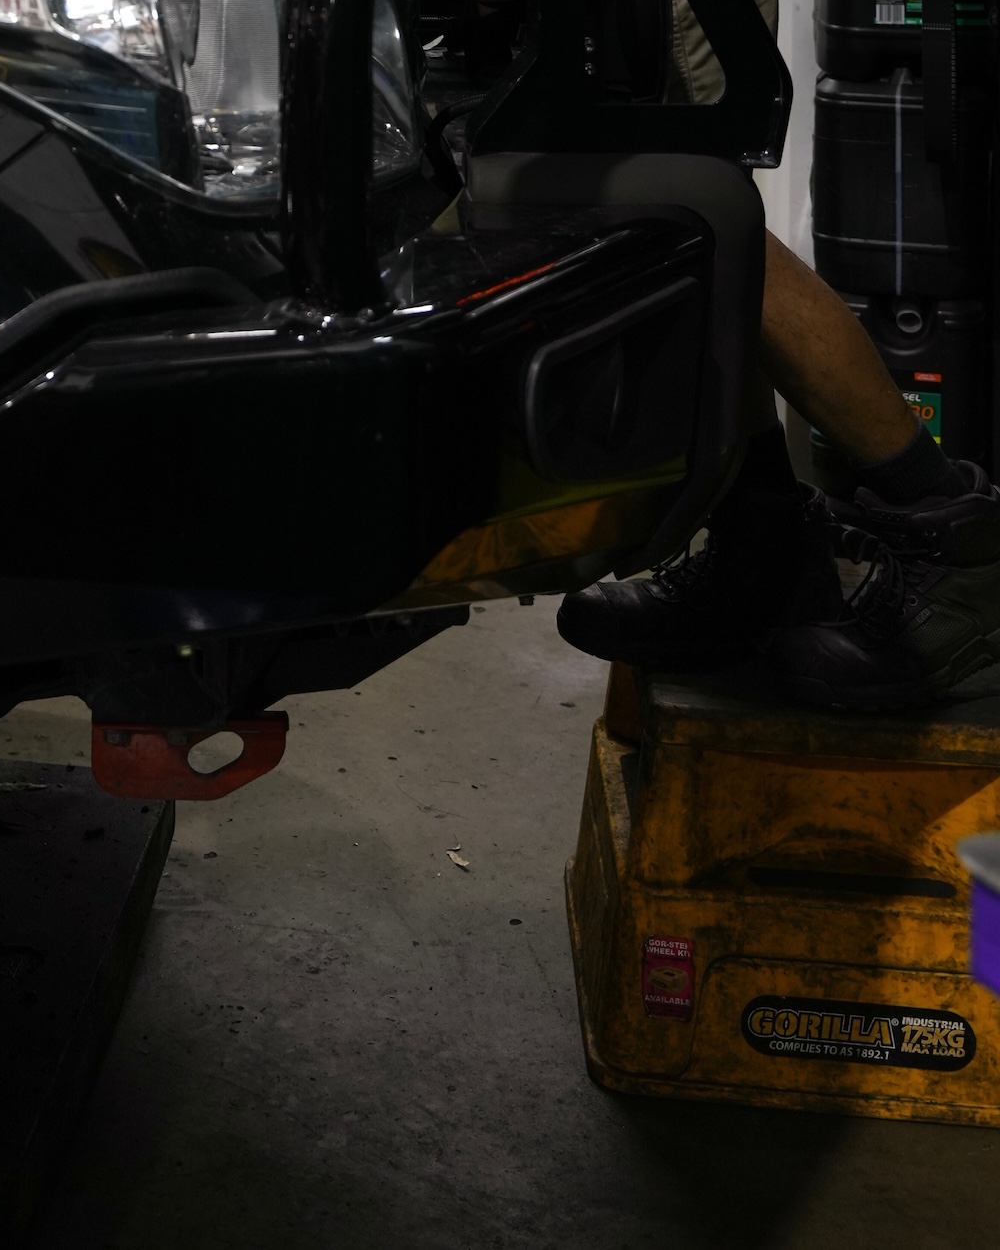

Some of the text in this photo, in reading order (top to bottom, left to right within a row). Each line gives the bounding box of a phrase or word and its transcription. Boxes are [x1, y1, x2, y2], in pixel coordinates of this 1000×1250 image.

[902, 393, 921, 402] SEL
[646, 947, 675, 956] WHEEL
[645, 994, 691, 1006] AVAILABLE
[902, 1016, 966, 1031] INDUSTRIAL
[901, 1025, 965, 1048] 175KG
[769, 1040, 821, 1055] COMPLIES
[823, 1045, 838, 1055] TO
[839, 1047, 854, 1058] AS
[901, 1042, 966, 1059] MAX LOAD
